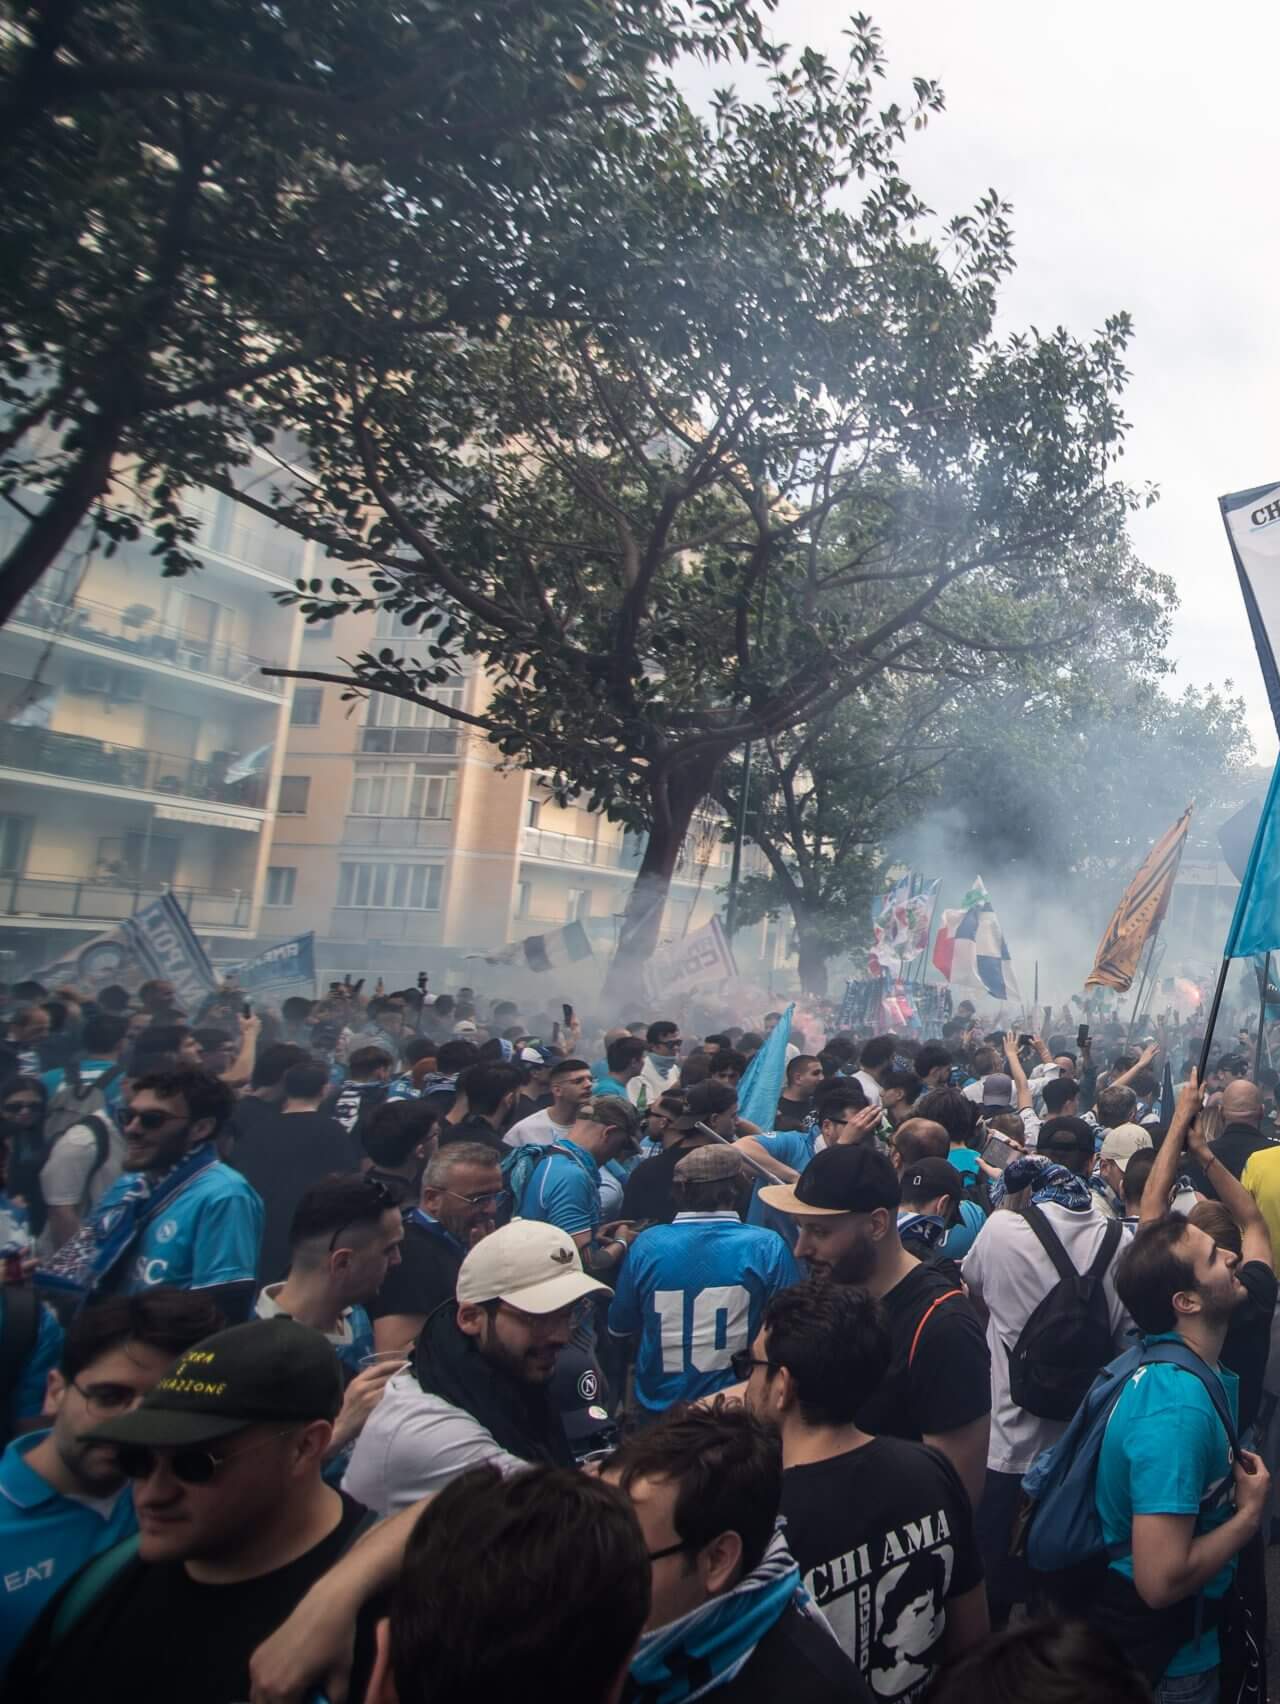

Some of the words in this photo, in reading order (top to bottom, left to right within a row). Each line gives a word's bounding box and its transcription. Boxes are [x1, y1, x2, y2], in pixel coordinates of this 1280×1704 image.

[654, 1285, 752, 1374] 10
[4, 1558, 54, 1592] EA7
[803, 1543, 872, 1601] CHI
[881, 1509, 951, 1567] AMA
[858, 1583, 872, 1672] DIEGO
